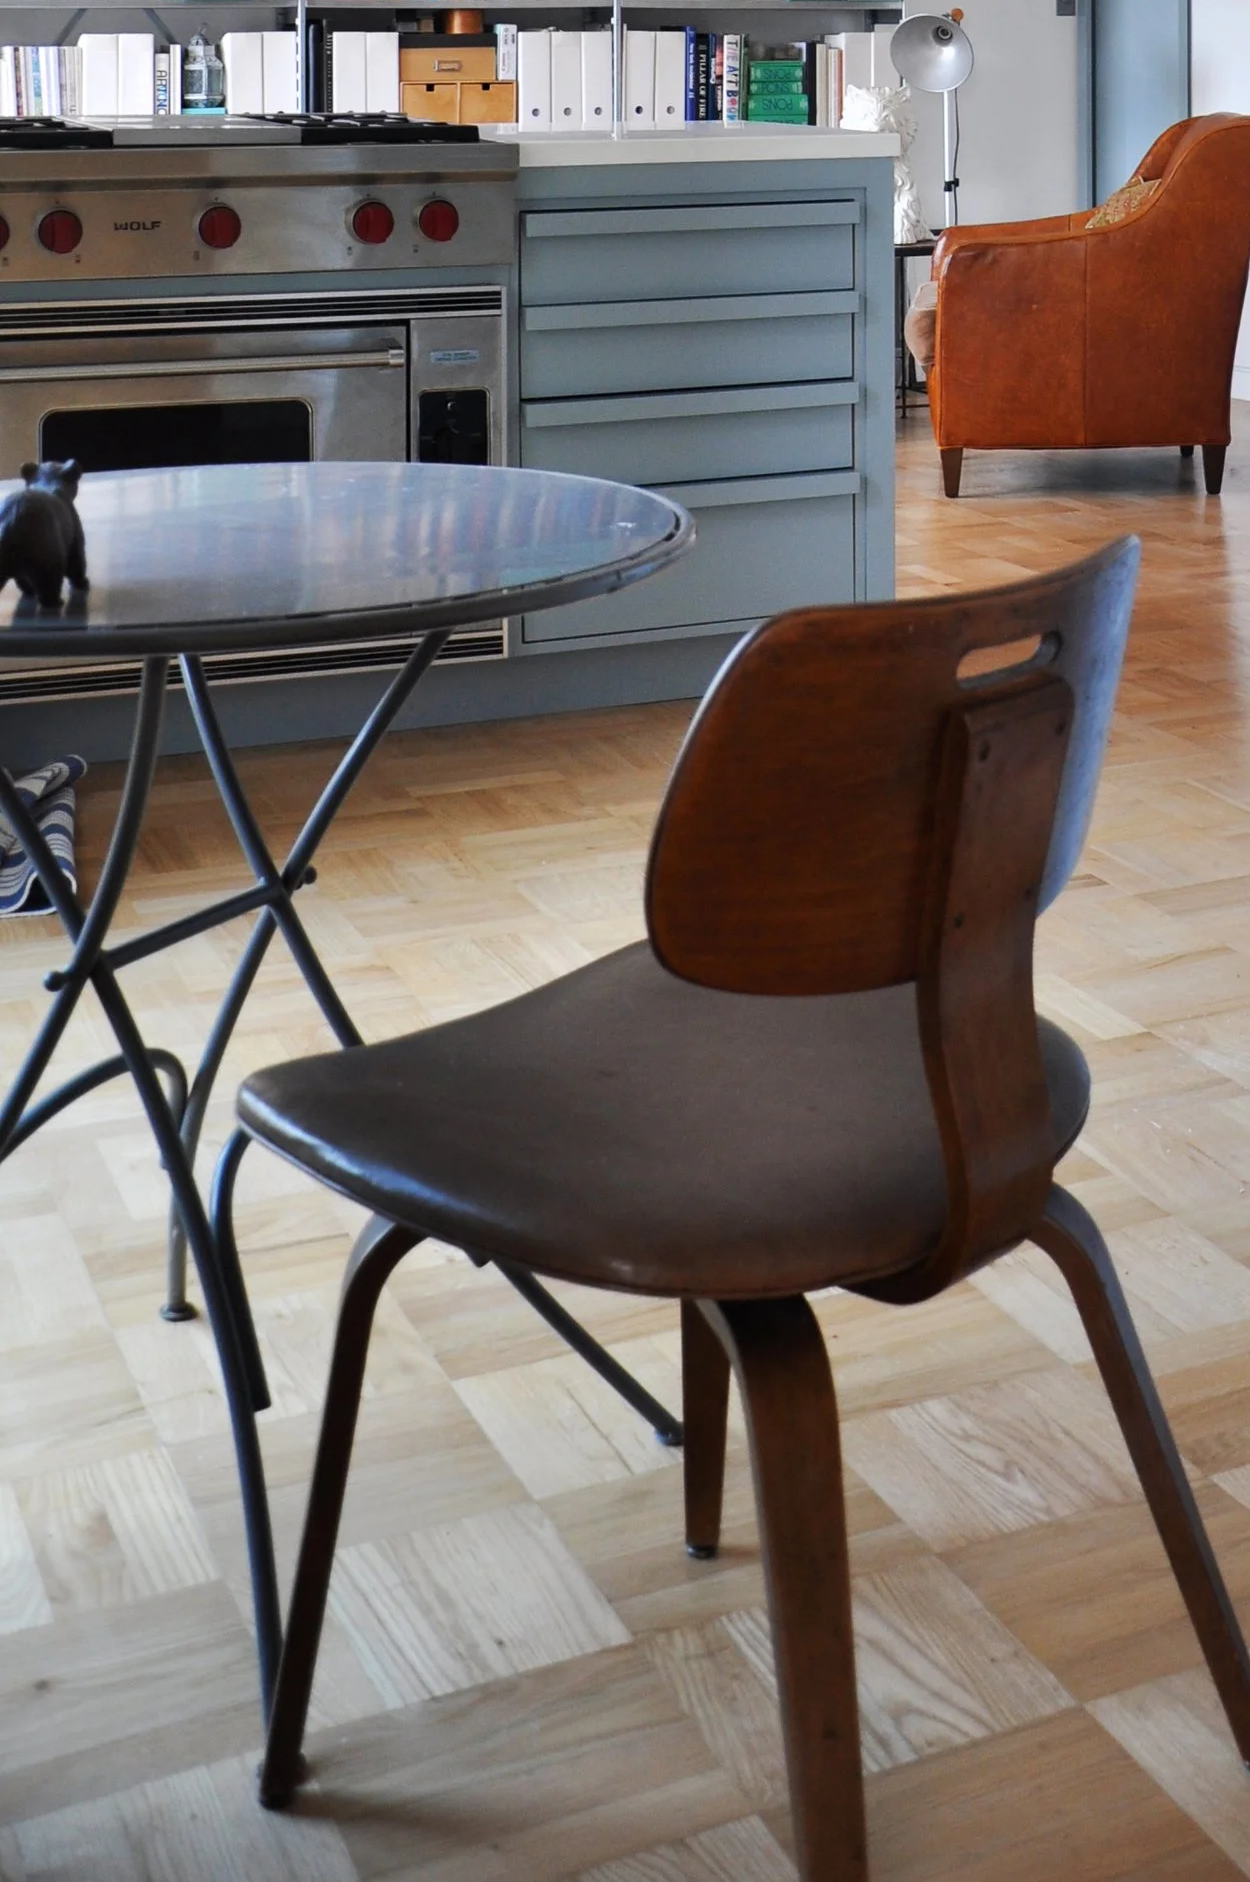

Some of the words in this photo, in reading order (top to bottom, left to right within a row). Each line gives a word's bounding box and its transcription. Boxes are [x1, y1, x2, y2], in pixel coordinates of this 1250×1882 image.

[727, 39, 738, 62] THE
[699, 86, 706, 96] OF
[762, 98, 793, 111] PONS
[113, 221, 162, 231] WOLF
